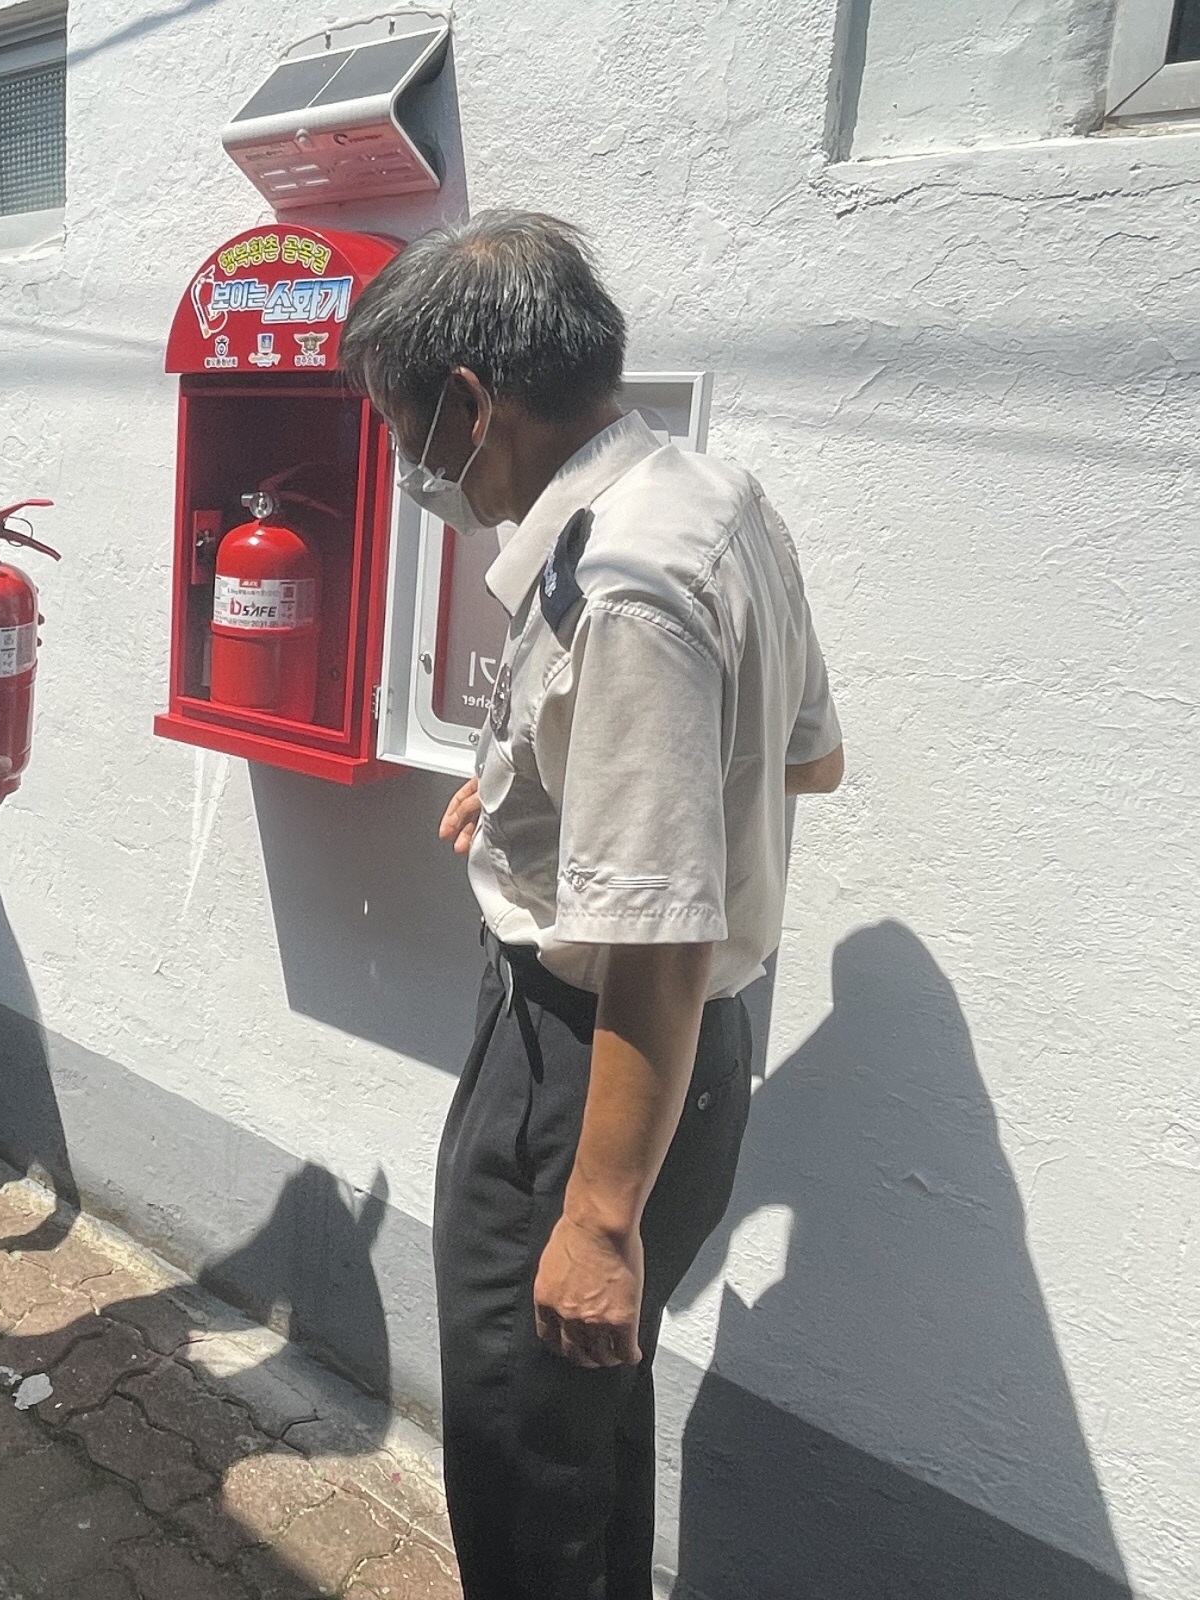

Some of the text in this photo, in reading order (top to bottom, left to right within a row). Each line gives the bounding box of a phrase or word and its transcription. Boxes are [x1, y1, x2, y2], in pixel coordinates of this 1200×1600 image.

[219, 234, 331, 275] 행복황촌 골목길
[212, 277, 352, 321] 보이는 소화기
